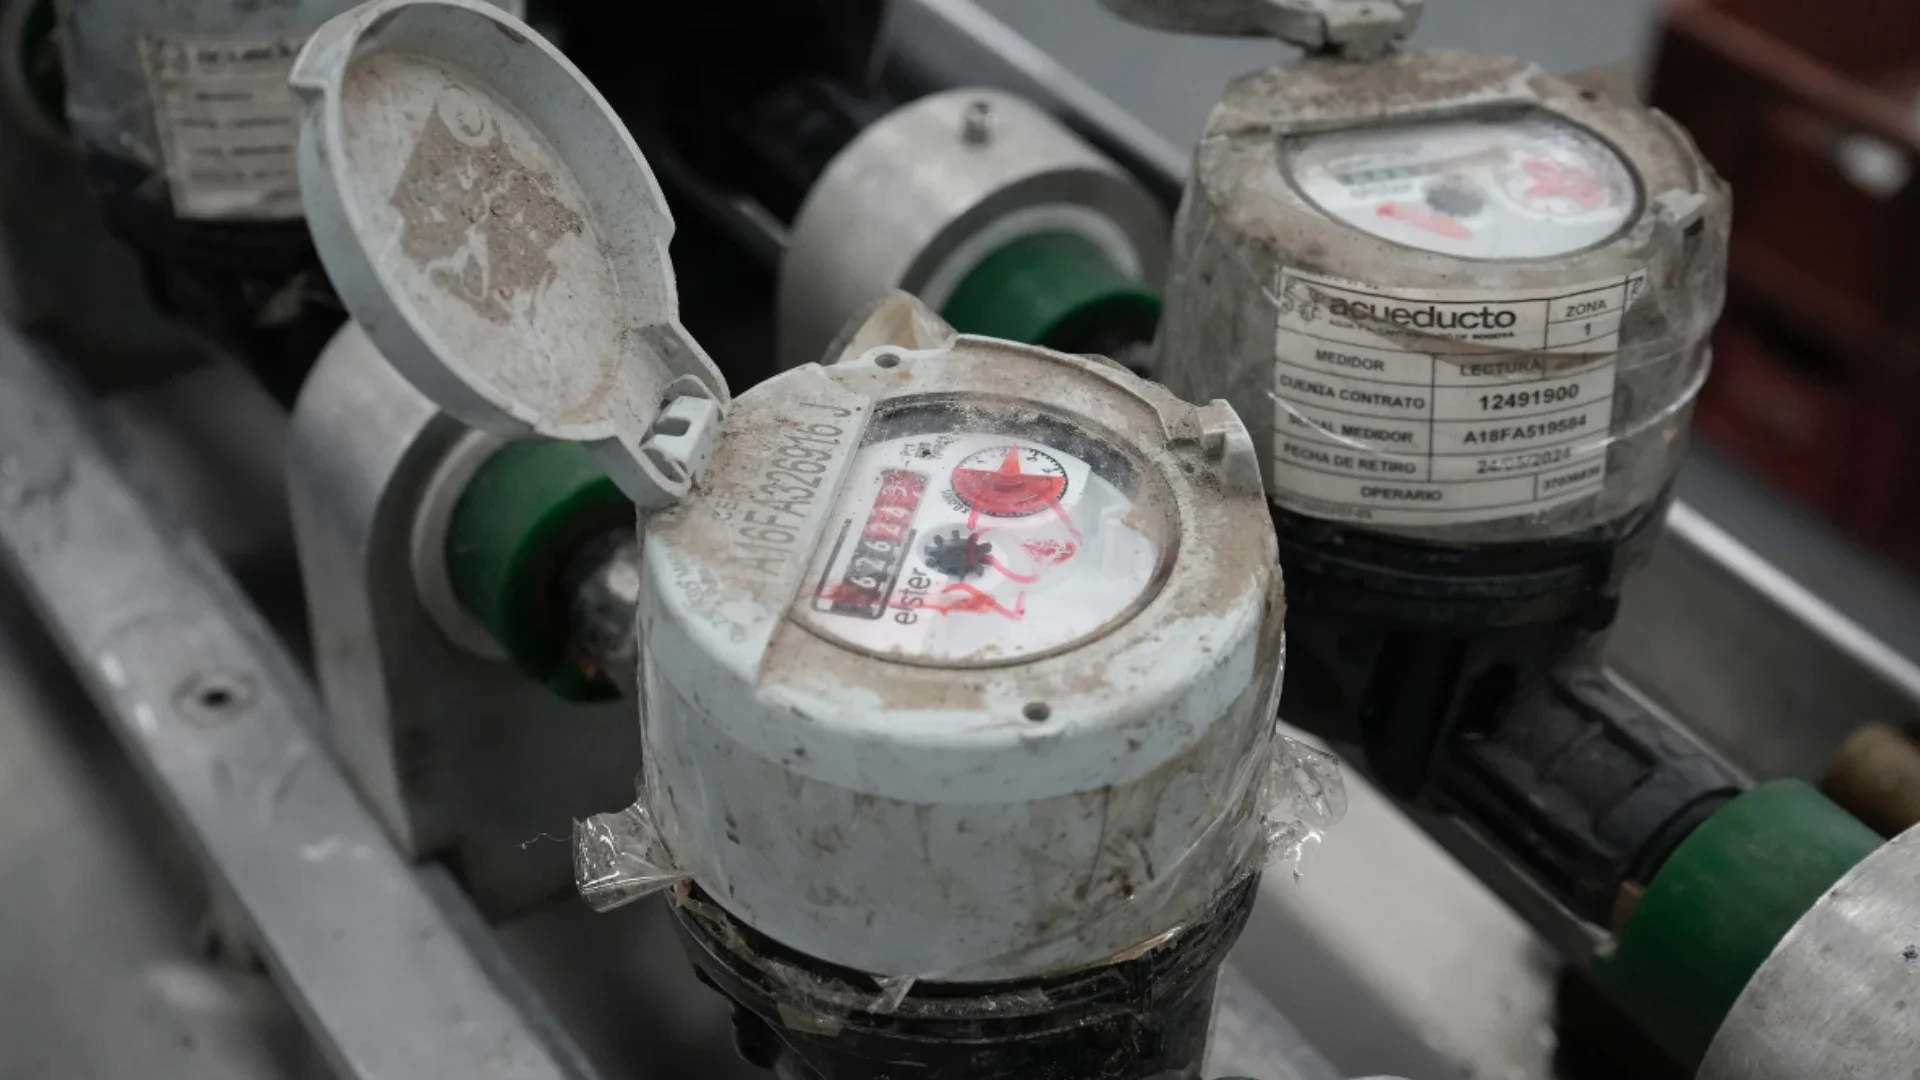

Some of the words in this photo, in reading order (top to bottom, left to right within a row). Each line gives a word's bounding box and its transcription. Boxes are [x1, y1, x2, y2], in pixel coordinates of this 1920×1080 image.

[1329, 299, 1516, 329] acueducto
[1565, 299, 1608, 317] ZONA
[1583, 322, 1592, 336] 1
[1316, 349, 1385, 372] MEDIDOR
[1460, 358, 1543, 377] LECTURA
[1280, 374, 1336, 398] CUENTA
[1339, 389, 1426, 410] CONTRATO
[1479, 383, 1580, 411] 12491900
[1341, 424, 1413, 443] MEDIDOR
[1463, 414, 1587, 444] A18FA519584
[1284, 442, 1330, 464] FECHA
[1334, 455, 1353, 468] DE
[1358, 457, 1417, 474] RETIRO
[1360, 485, 1443, 501] OPERARIO
[894, 566, 932, 626] elster
